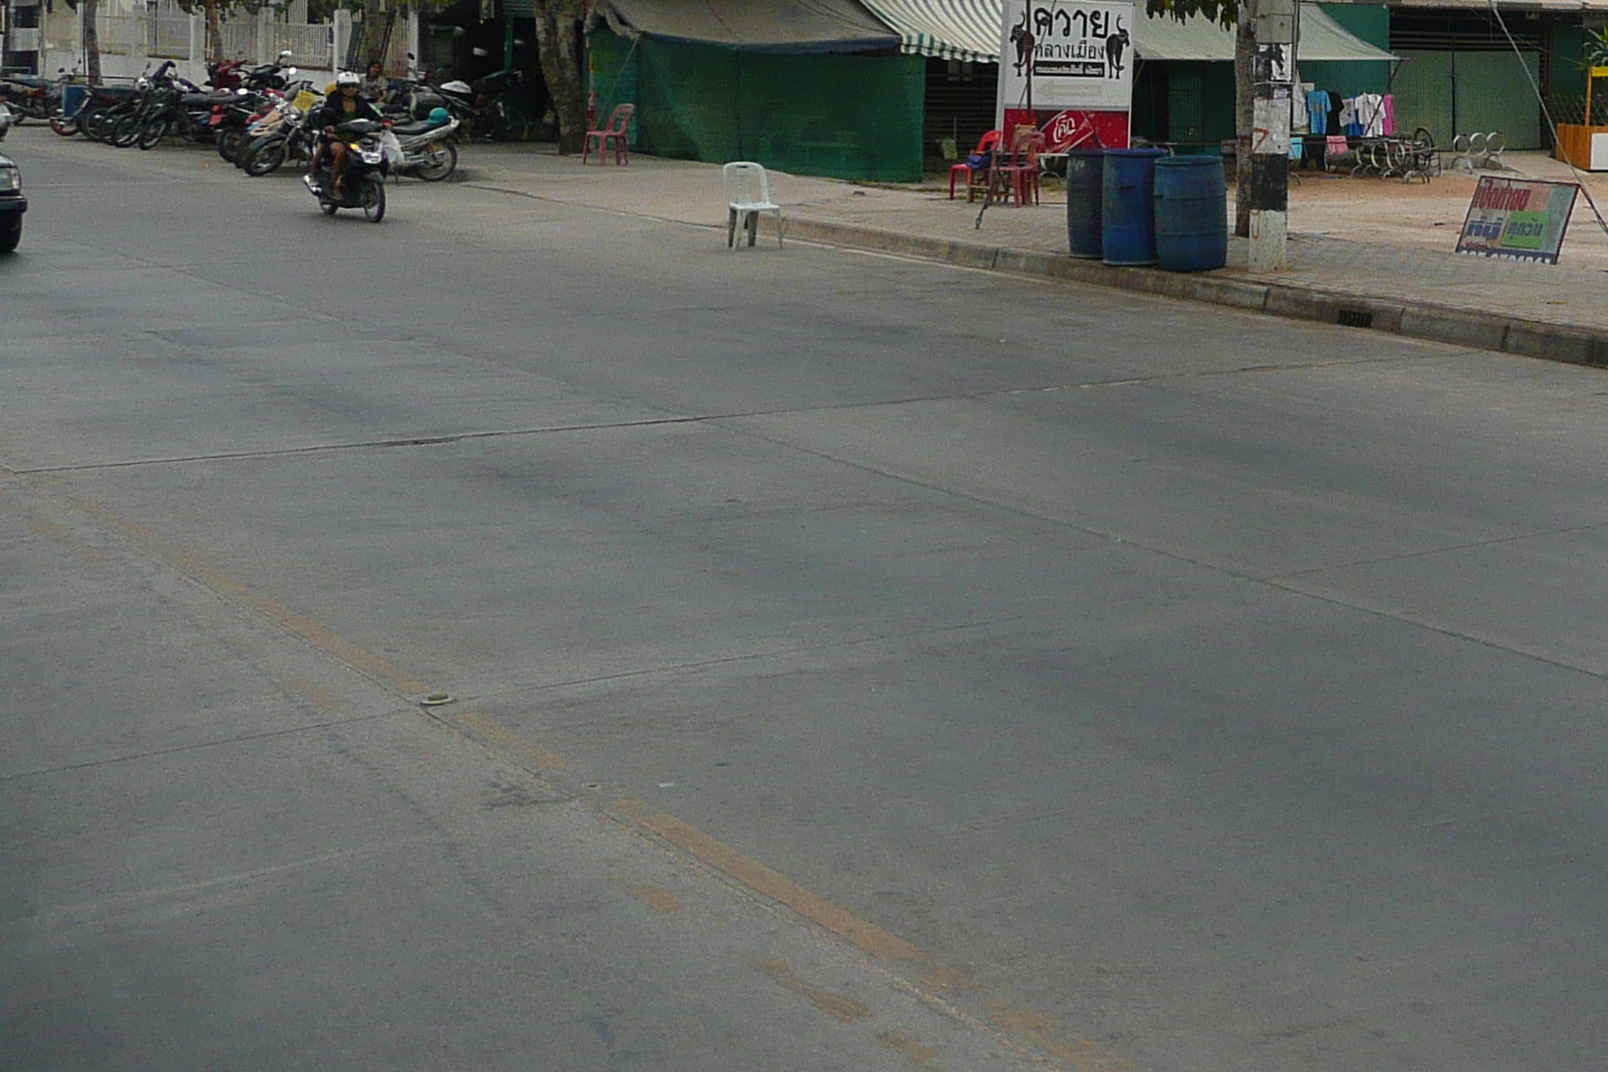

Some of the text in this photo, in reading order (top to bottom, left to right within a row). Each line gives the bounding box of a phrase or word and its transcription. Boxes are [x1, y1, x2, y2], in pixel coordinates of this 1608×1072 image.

[1034, 7, 1109, 38] ควาย
[1035, 40, 1105, 59] กลางเมือง
